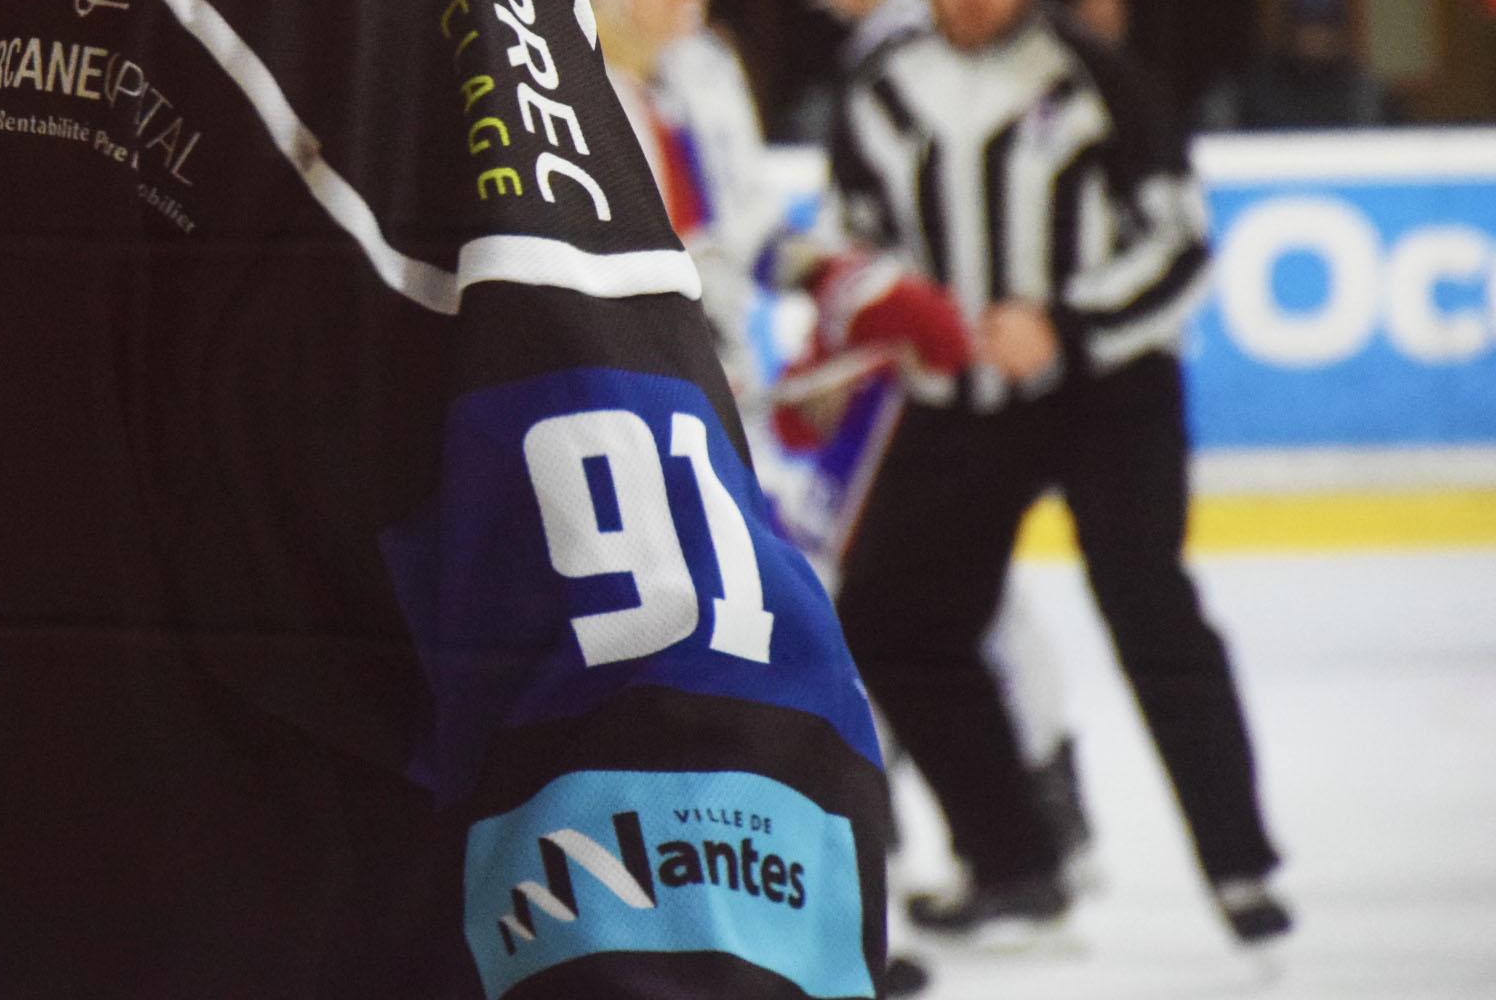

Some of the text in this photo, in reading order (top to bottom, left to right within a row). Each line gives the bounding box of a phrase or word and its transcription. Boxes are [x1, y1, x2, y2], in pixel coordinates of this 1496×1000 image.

[1220, 195, 1496, 367] Oc
[522, 408, 776, 668] 91
[672, 808, 774, 835] VILLE DE
